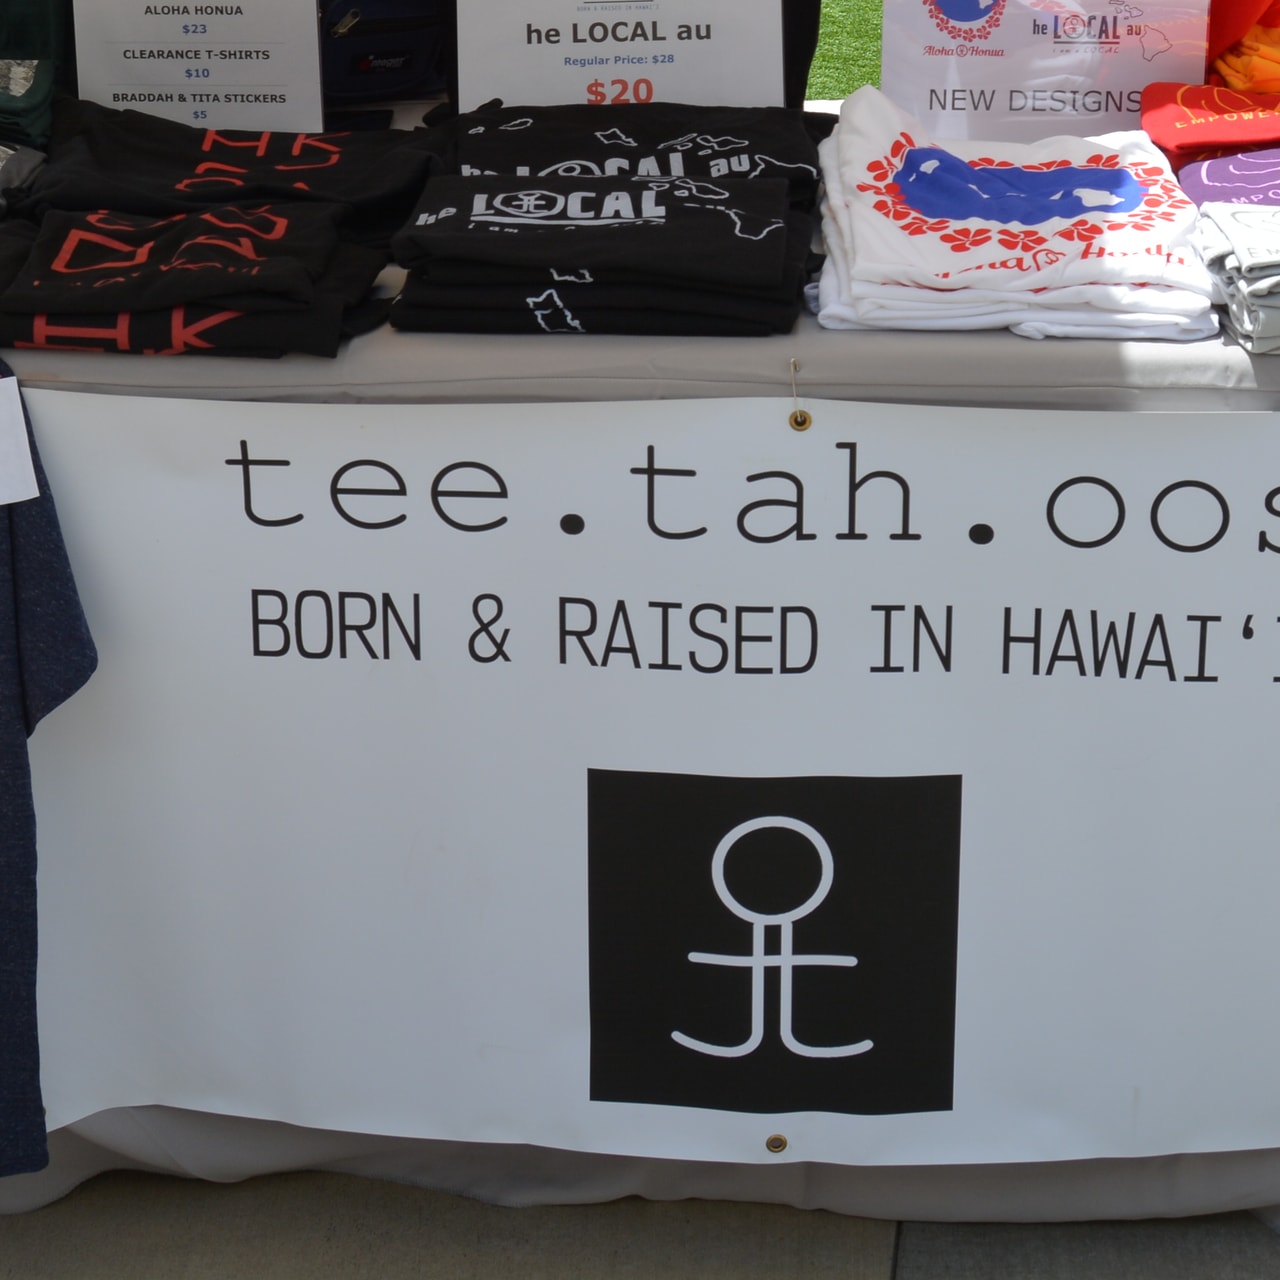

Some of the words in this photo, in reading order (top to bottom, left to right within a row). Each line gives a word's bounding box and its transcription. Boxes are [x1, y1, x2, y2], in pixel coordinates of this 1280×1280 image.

[144, 5, 191, 16] ALOHA
[194, 5, 244, 16] HONUA
[181, 23, 208, 36] $23
[525, 23, 561, 45] he
[571, 21, 667, 45] LOCAL
[676, 23, 712, 41] au
[1032, 18, 1048, 36] he
[1126, 22, 1142, 36] au
[123, 49, 202, 61] CLEARANCE
[205, 49, 271, 61] T-SHIRTS
[922, 43, 955, 58] Aloha
[968, 45, 1006, 58] Honua
[563, 55, 611, 68] Regular
[613, 55, 649, 66] Price:
[651, 53, 675, 65] $28
[184, 68, 210, 80] $10
[112, 93, 175, 103] BRADDAH
[177, 93, 188, 103] &
[190, 93, 221, 104] TITA
[224, 93, 287, 105] STICKERS
[585, 78, 654, 106] $20
[929, 88, 996, 112] NEW
[1009, 89, 1142, 113] DESIGNS
[192, 110, 208, 121] $5
[709, 153, 751, 178] au
[250, 589, 422, 662] BORN
[467, 592, 512, 664] &
[558, 596, 819, 675] RAISED
[870, 604, 954, 673] IN
